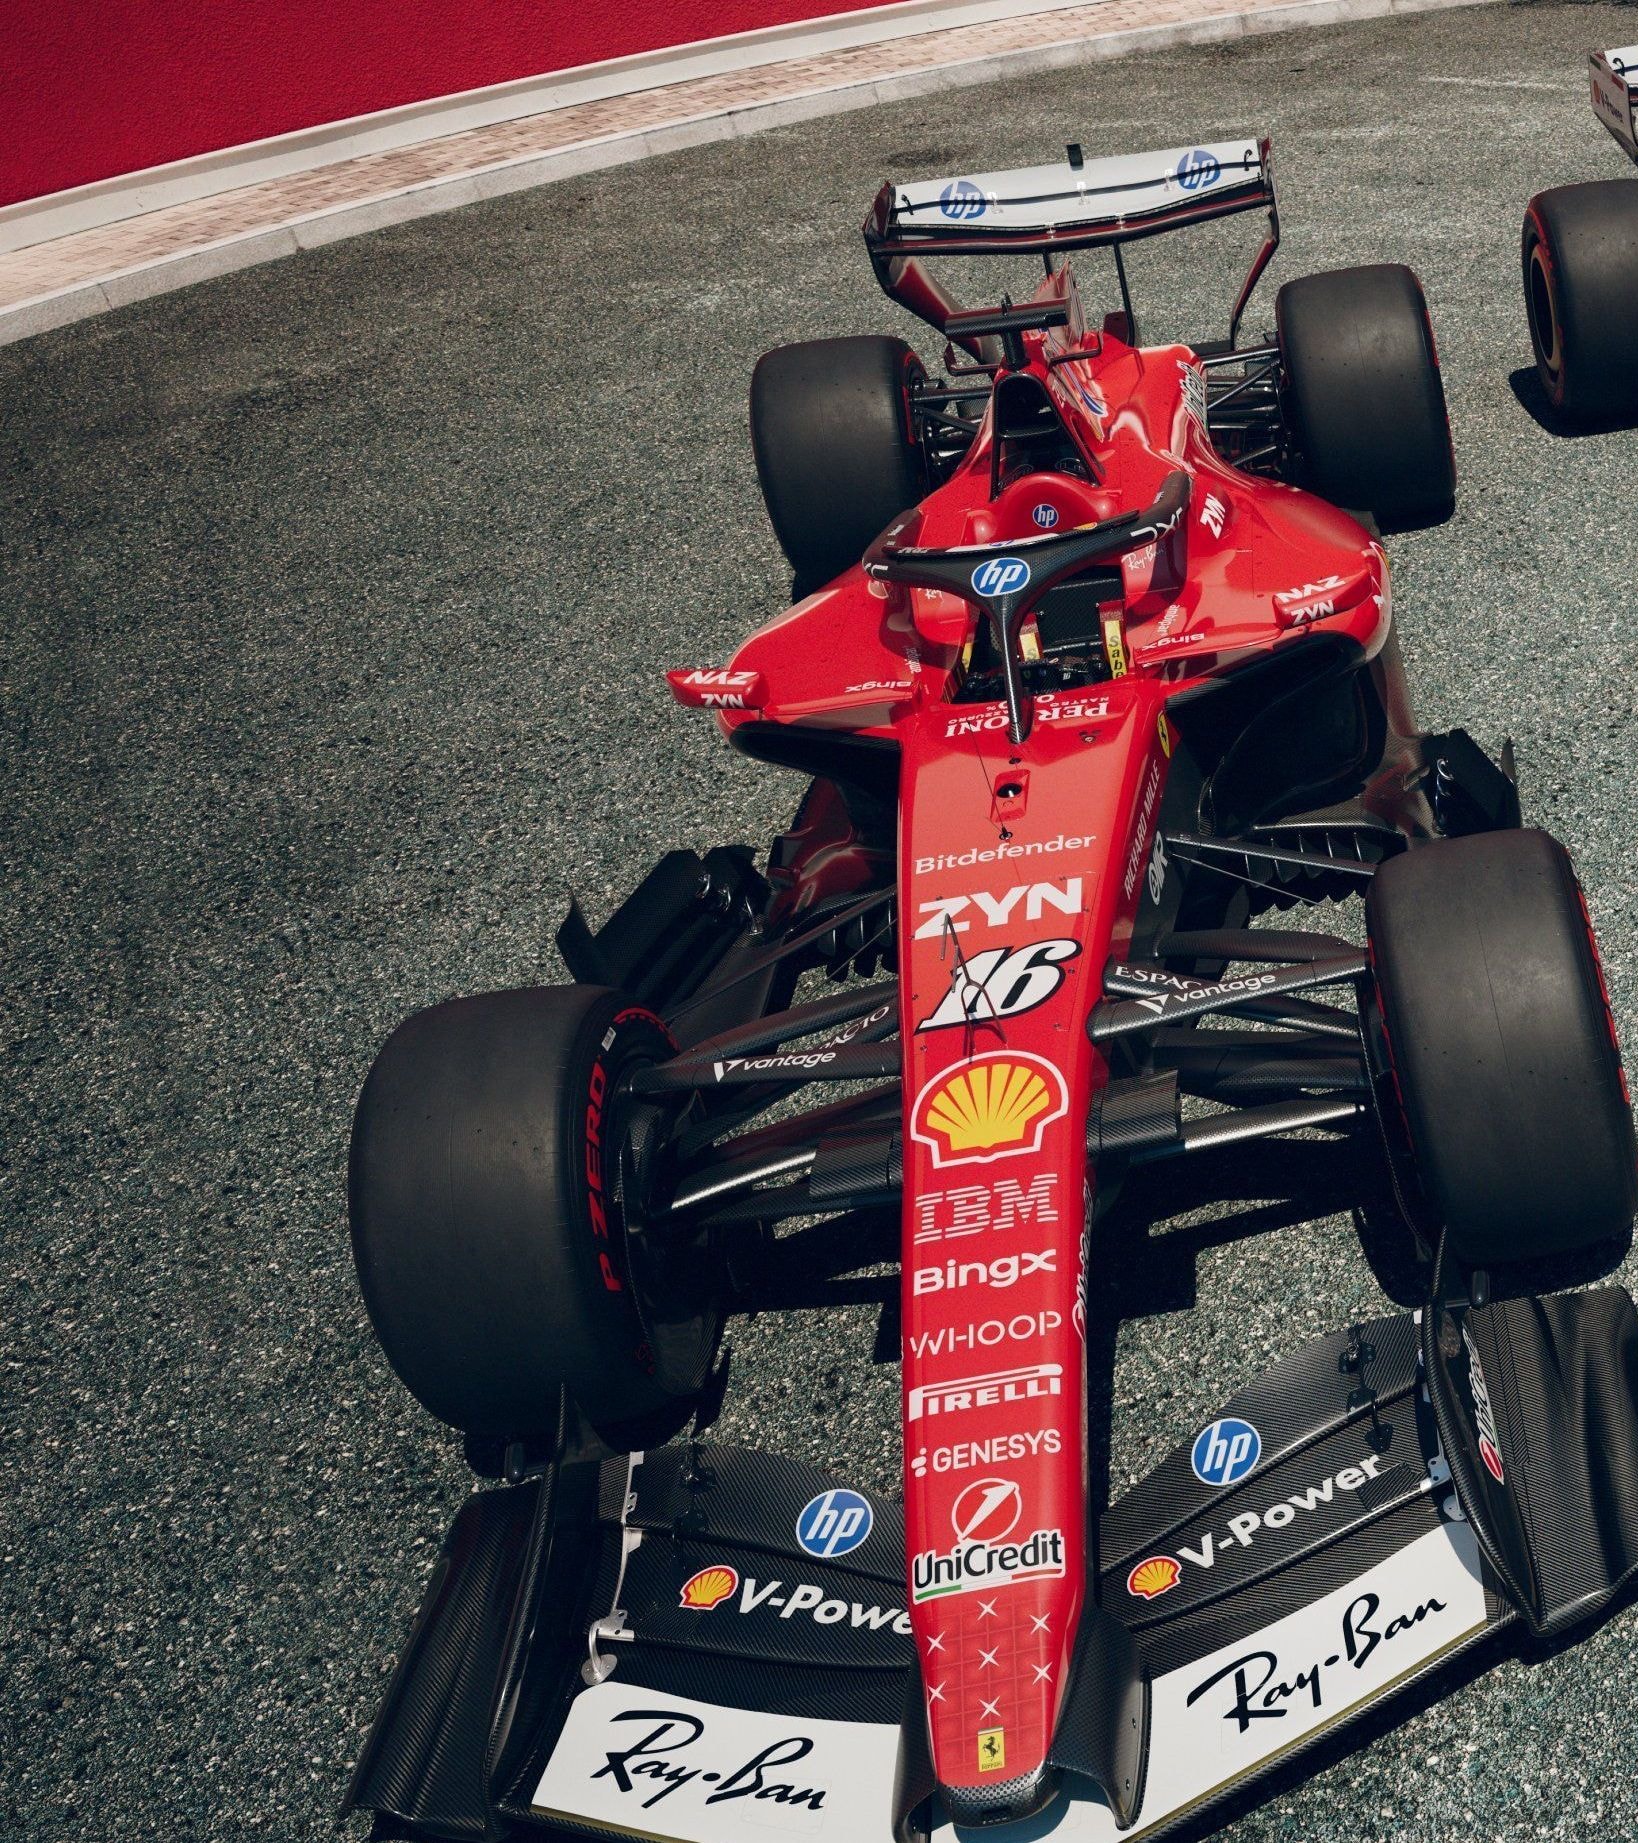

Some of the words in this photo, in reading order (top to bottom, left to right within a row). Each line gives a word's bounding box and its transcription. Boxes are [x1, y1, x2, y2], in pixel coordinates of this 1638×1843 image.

[1182, 150, 1218, 189] hp
[947, 181, 983, 219] hp
[1037, 504, 1056, 528] hp
[1200, 493, 1226, 539] ZYN
[979, 558, 1022, 596] hp
[1275, 575, 1345, 603] ZYN
[1291, 599, 1335, 625] ZYN
[683, 671, 757, 685] ZYN
[1108, 635, 1125, 680] Sabe
[701, 693, 744, 708] ZYN
[1124, 812, 1147, 900] RICHARD
[1143, 760, 1160, 819] MILLE
[915, 834, 1096, 875] Bitdefender
[914, 877, 1083, 940] ZYN
[914, 935, 1083, 1035] 16
[1174, 973, 1276, 1002] vantage
[744, 1052, 837, 1070] vantage
[585, 1061, 608, 1240] ZERO
[914, 1173, 1058, 1245] IBM
[913, 1249, 1057, 1296] BingX
[910, 1311, 1062, 1359] WHOOP
[909, 1364, 1063, 1422] PIRELLI
[932, 1429, 1062, 1472] GENESYS
[1201, 1418, 1252, 1486] hp
[804, 1489, 866, 1557] hp
[1176, 1454, 1380, 1569] V-Power
[914, 1531, 1062, 1589] UniCredit
[739, 1578, 913, 1635] V-Powe
[1186, 1592, 1447, 1733] Ray-Ban
[590, 1710, 828, 1810] Ray-Ban
